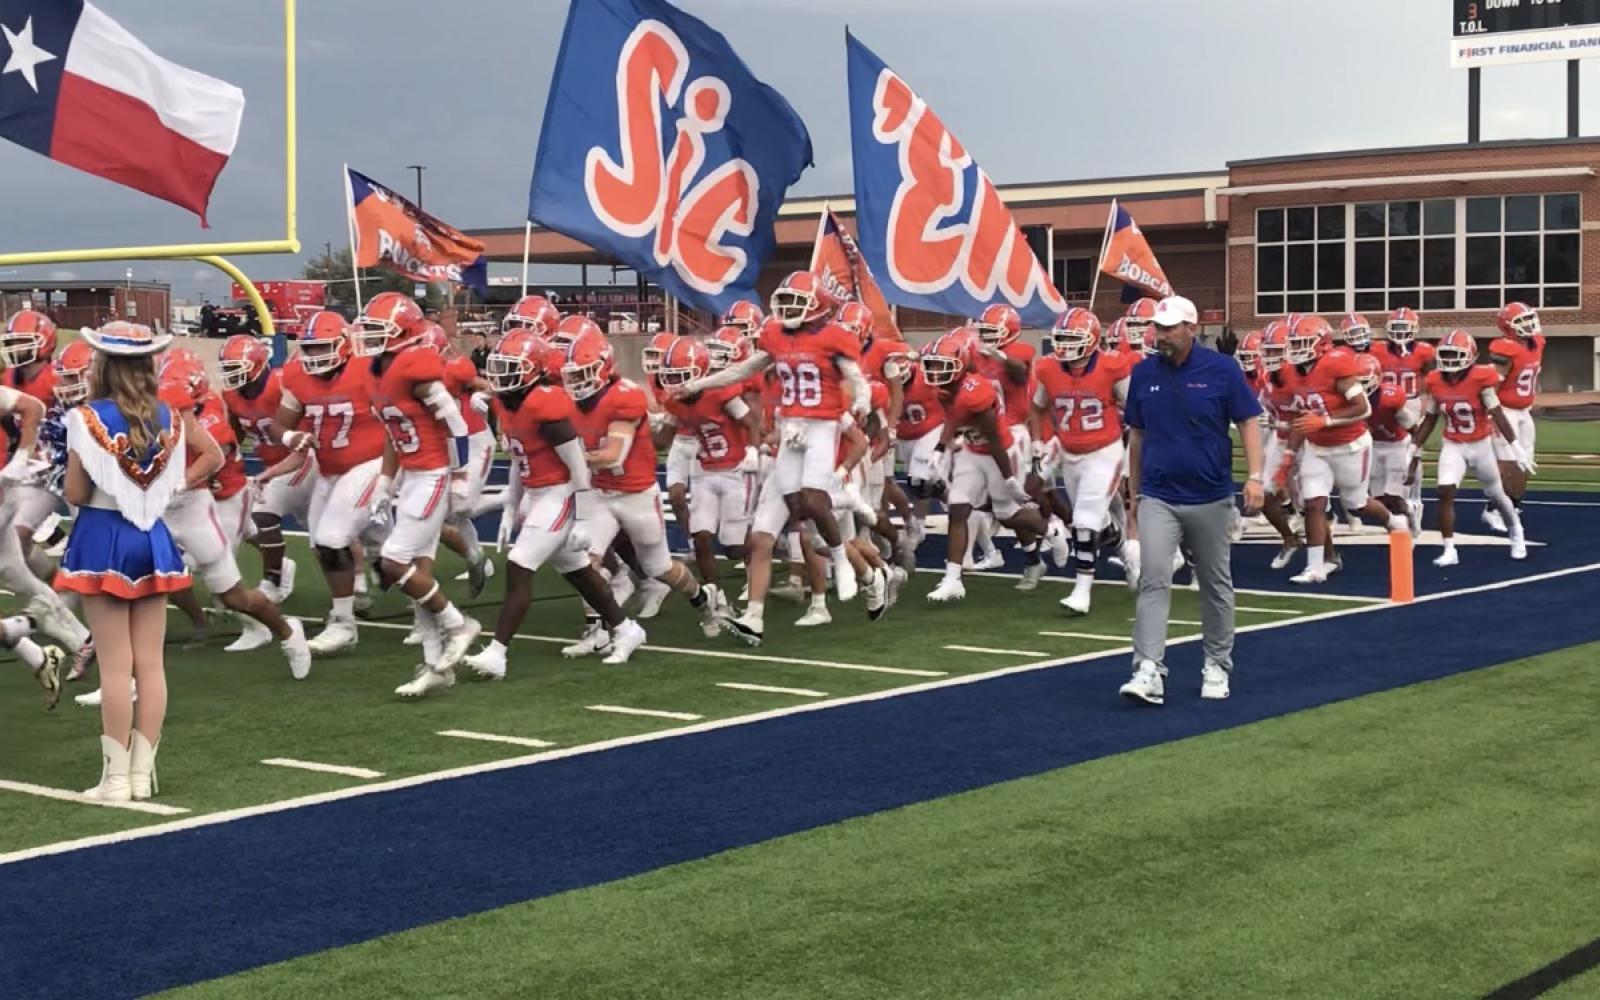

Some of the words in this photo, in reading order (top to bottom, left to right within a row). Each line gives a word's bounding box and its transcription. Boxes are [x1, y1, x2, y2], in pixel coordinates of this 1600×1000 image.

[1459, 20, 1488, 33] T.O.L.
[1459, 46, 1496, 58] FIRST
[1498, 40, 1566, 54] FINANCIAL
[1569, 36, 1600, 49] BAN
[584, 18, 760, 295] Sic
[304, 402, 355, 449] 77
[1055, 397, 1105, 432] 72
[1440, 401, 1476, 434] 19
